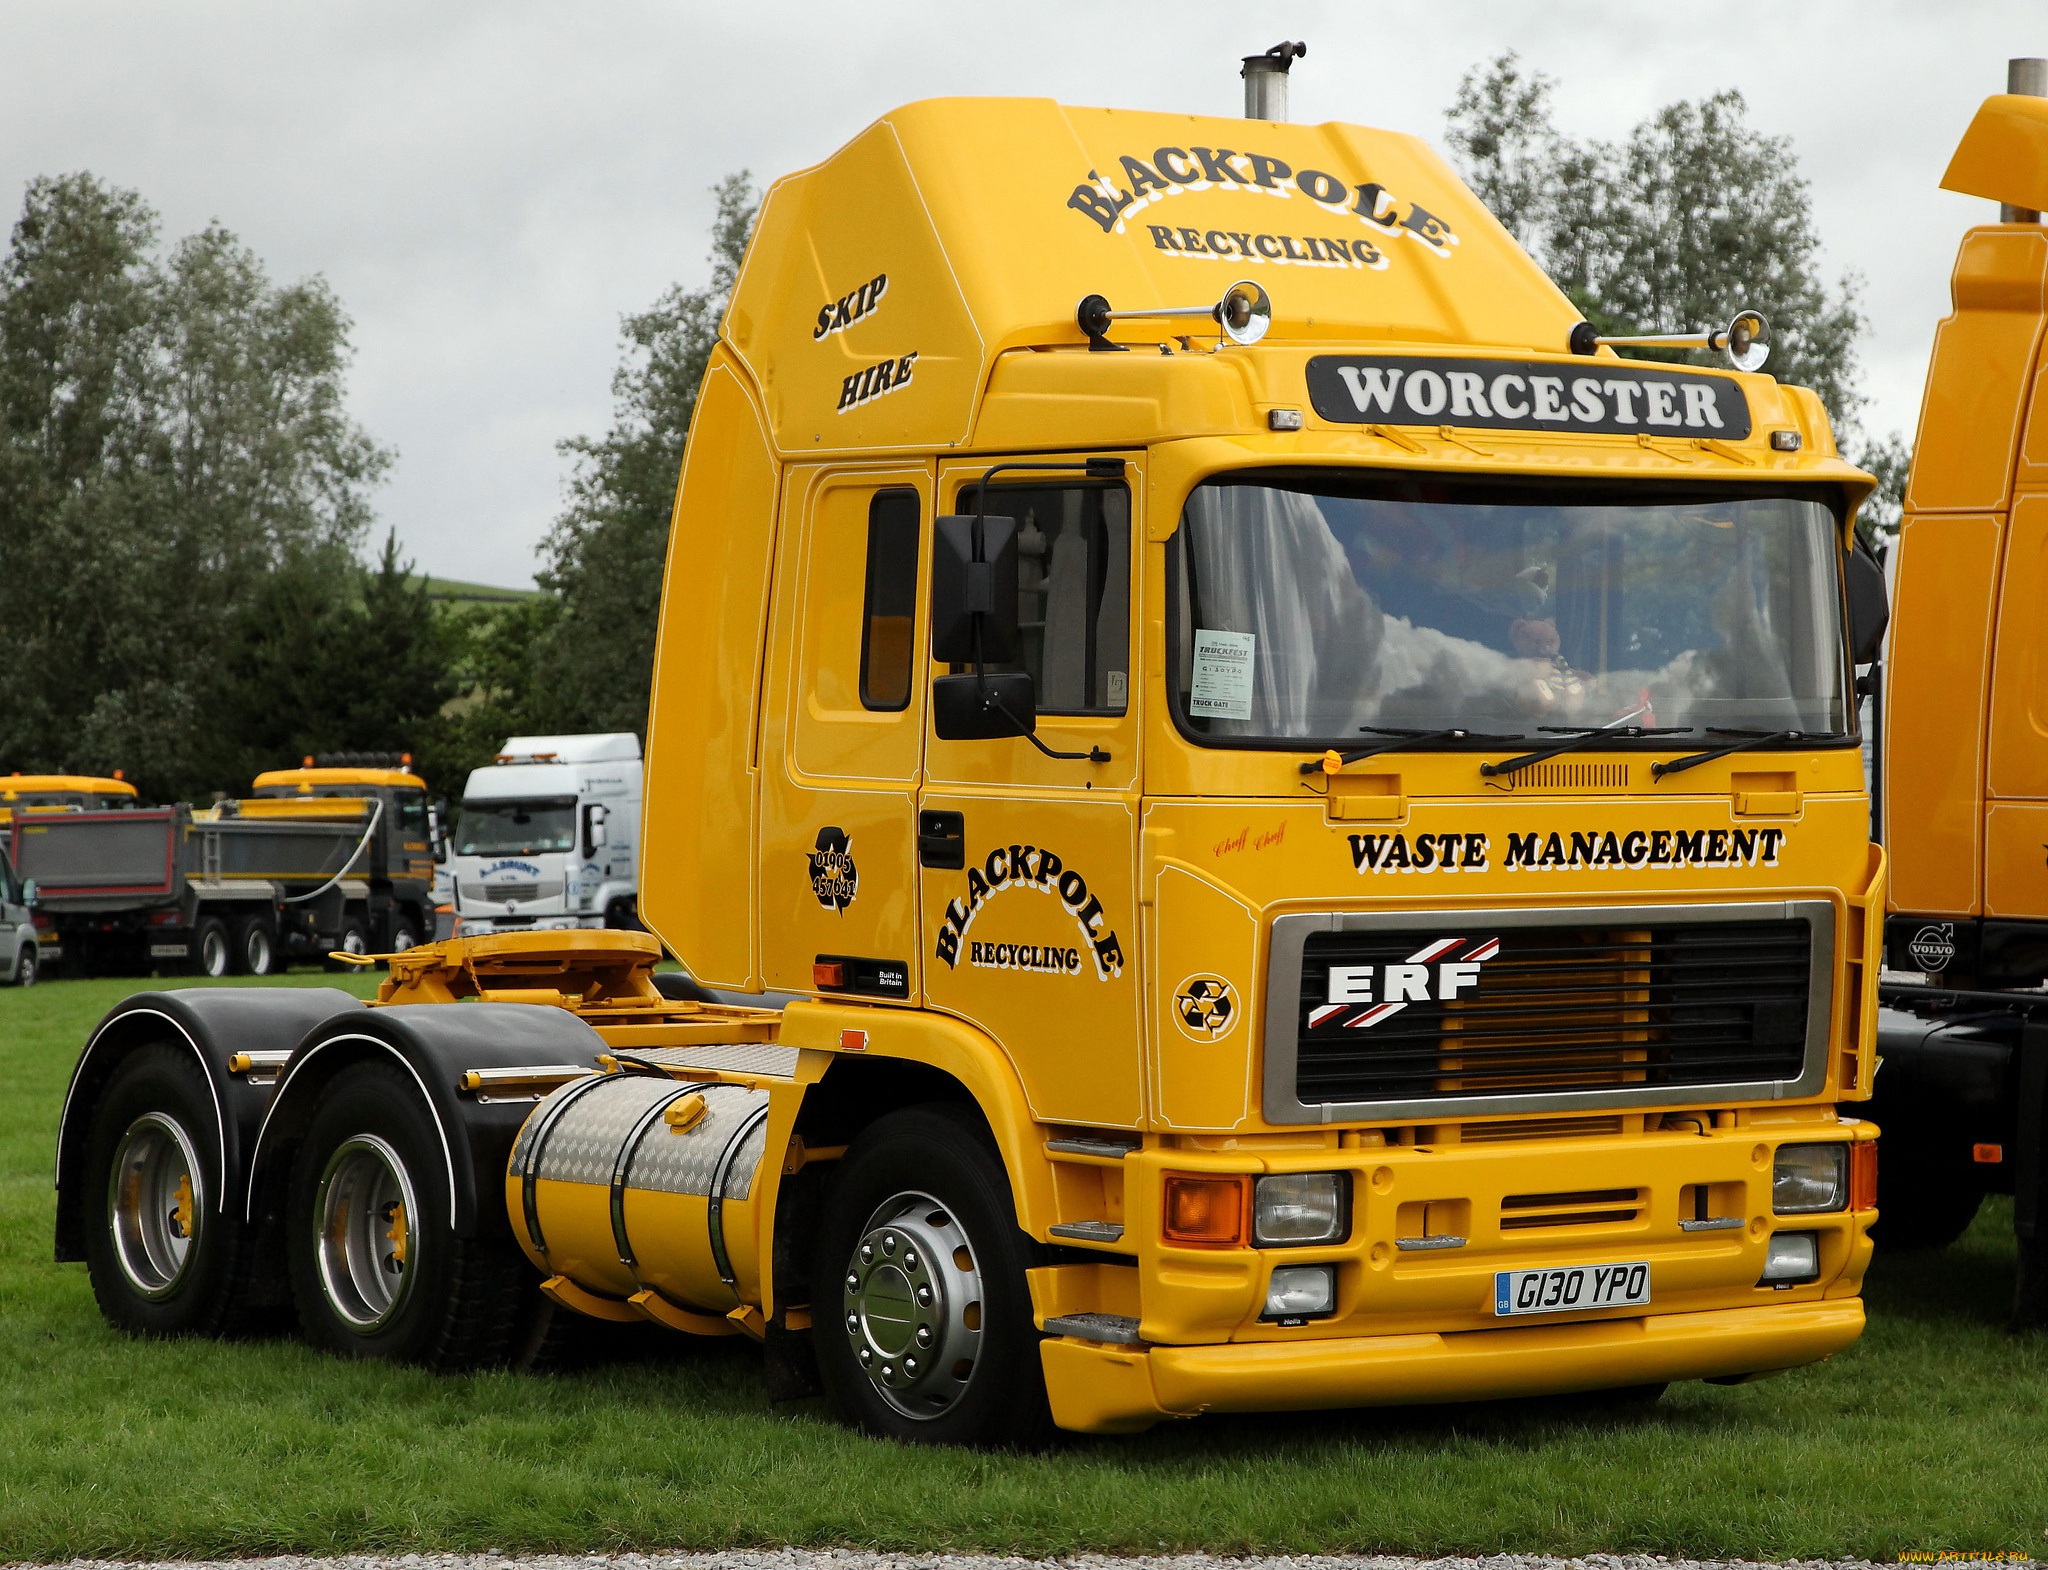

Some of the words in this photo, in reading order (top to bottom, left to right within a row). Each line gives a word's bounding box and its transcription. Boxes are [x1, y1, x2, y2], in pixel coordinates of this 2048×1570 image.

[1067, 147, 1457, 257] BLACKPOLE
[1146, 225, 1389, 270] RECYCLING
[813, 273, 889, 341] SKIP
[837, 351, 919, 414] HIRE
[1337, 366, 1725, 429] WORCESTER
[1199, 646, 1248, 657] TRUCKFEST
[815, 851, 851, 872] 01905
[1348, 833, 1490, 874] WASTE
[1503, 828, 1786, 871] MANAGEMENT
[812, 875, 856, 898] 457641
[936, 845, 1124, 982] BLACKPOLE
[970, 941, 1082, 975] RECYCLING
[1911, 944, 1953, 955] VOLVO
[879, 971, 895, 979] Built
[879, 978, 902, 986] Britain
[1328, 962, 1481, 1004] ERF
[1498, 1301, 1509, 1309] GB
[1517, 1271, 1585, 1308] G130
[1592, 1265, 1647, 1303] YPO
